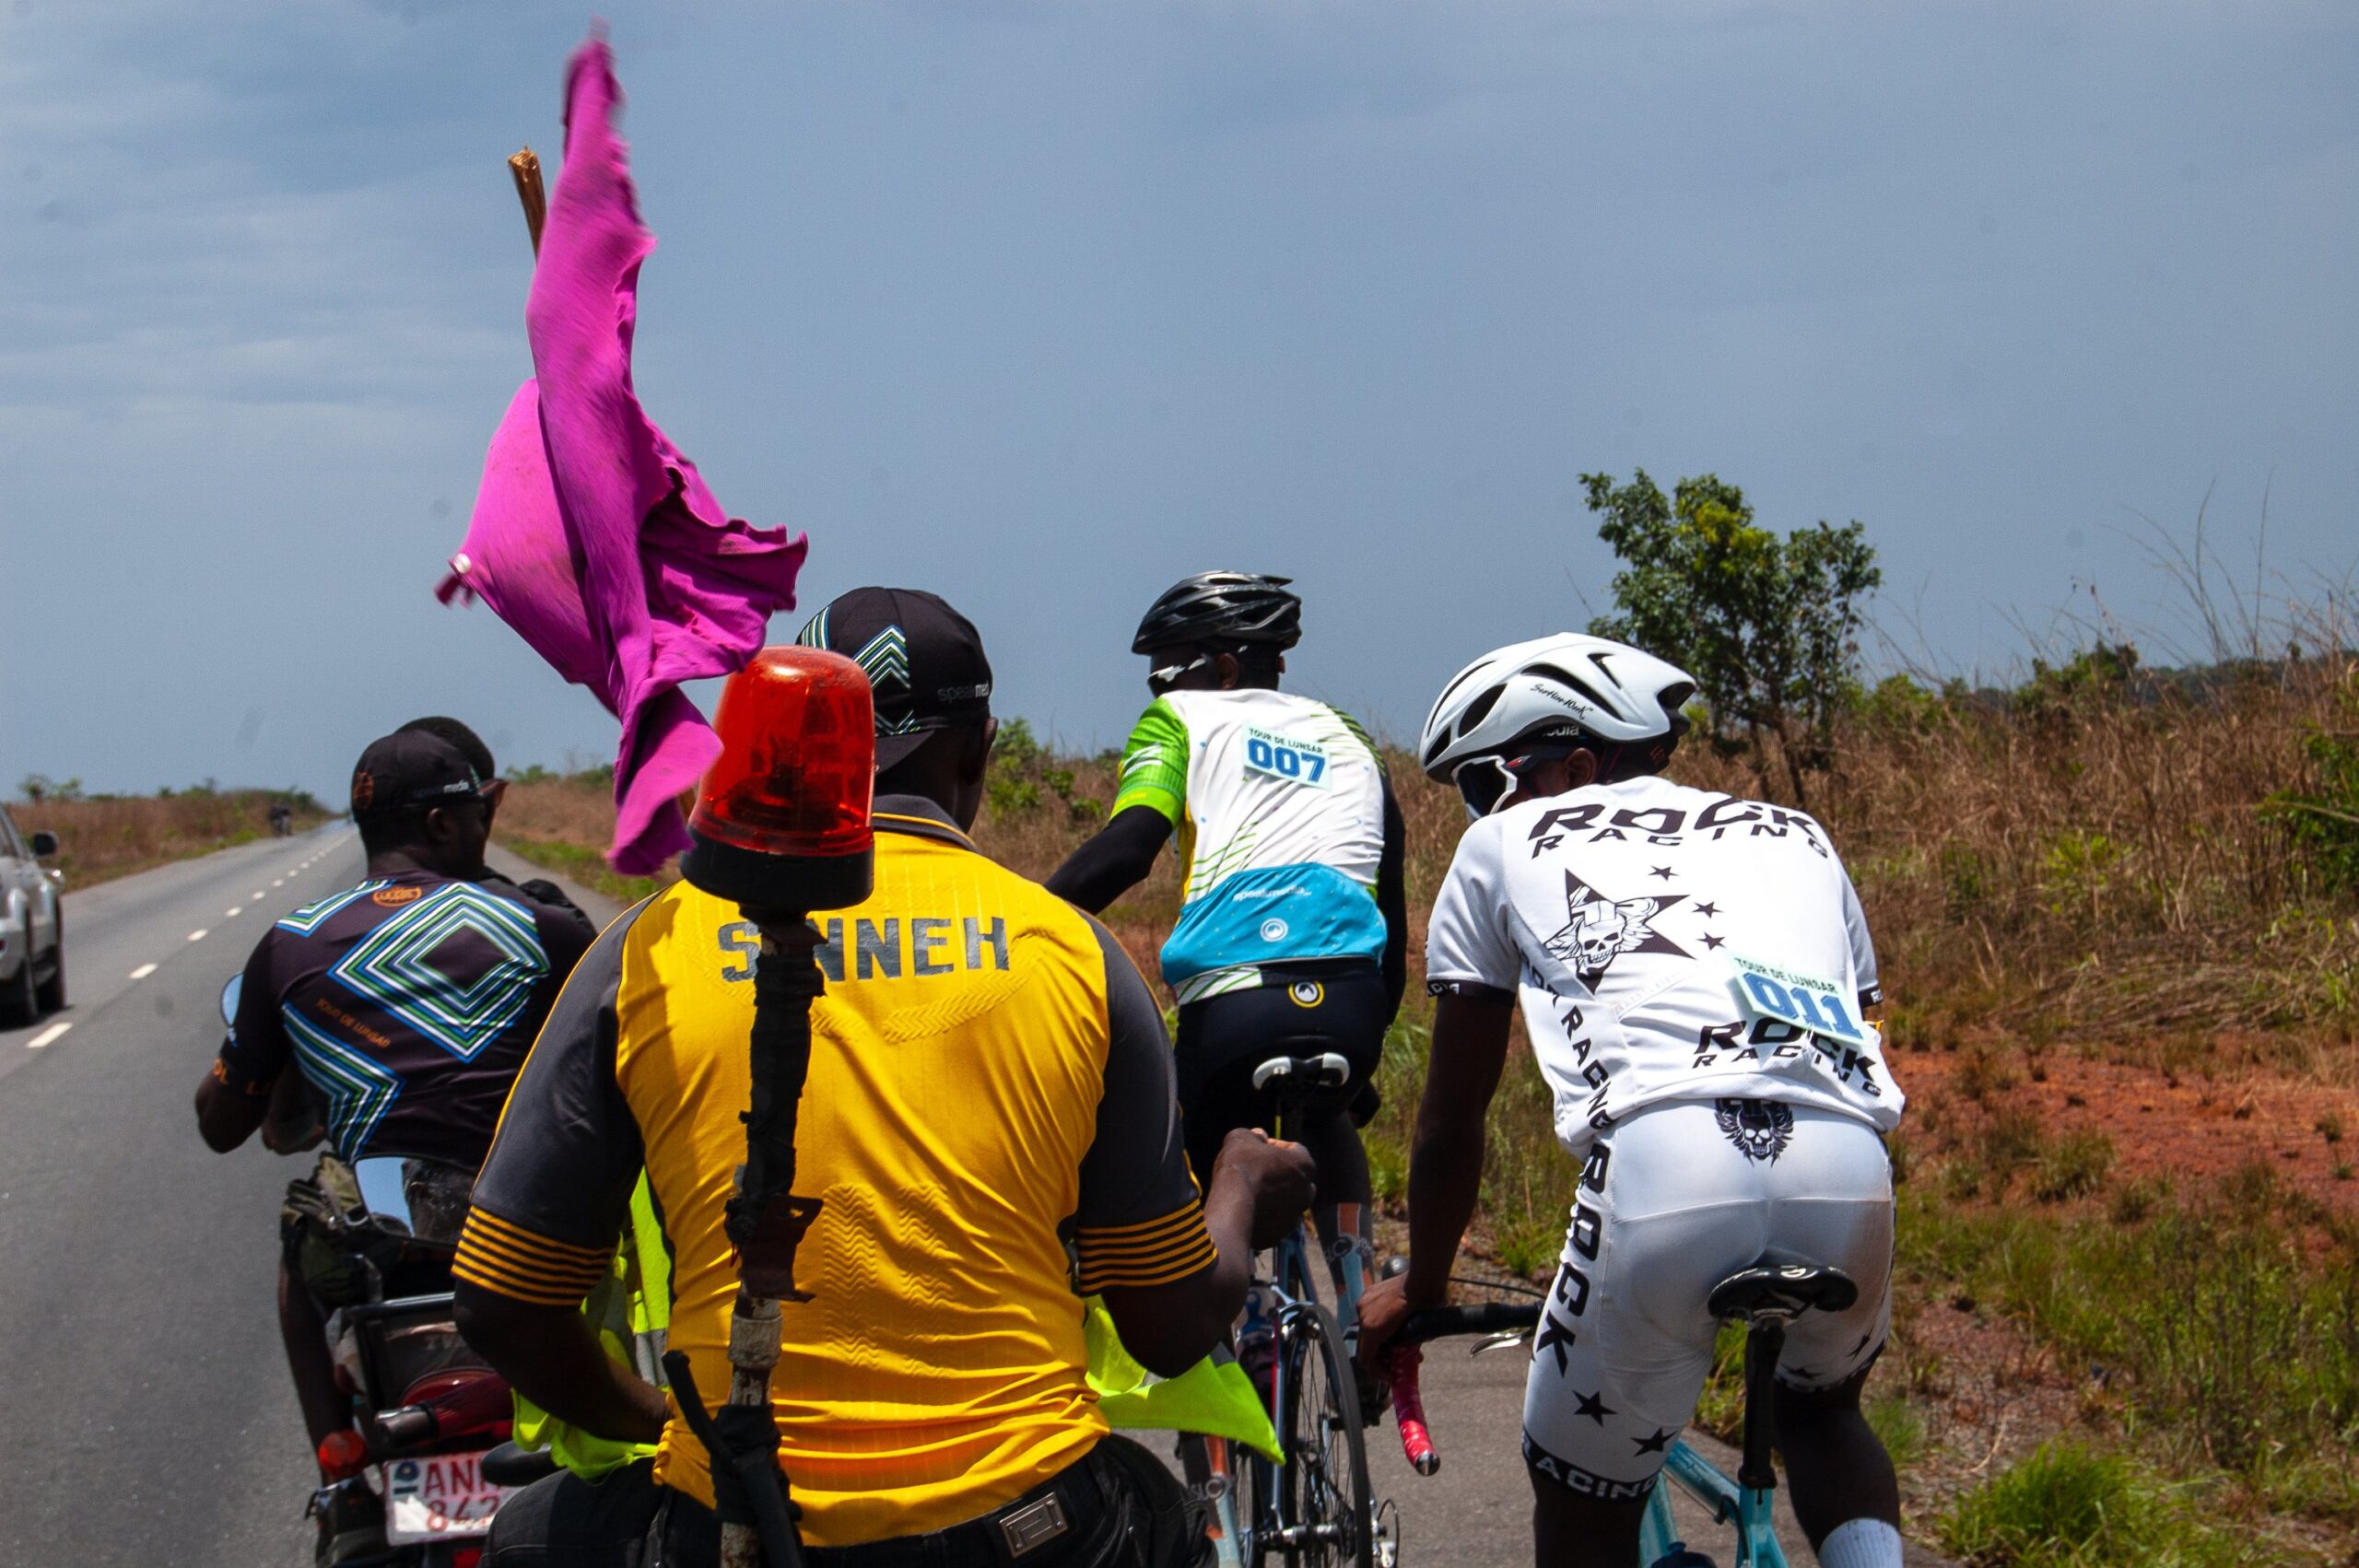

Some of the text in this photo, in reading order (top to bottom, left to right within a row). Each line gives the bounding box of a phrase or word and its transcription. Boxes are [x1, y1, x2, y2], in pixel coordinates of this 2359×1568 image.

[1248, 738, 1325, 783] 007
[1250, 728, 1323, 753] TOUR DE LUNSAR
[1528, 797, 1818, 840] ROCK
[1532, 824, 1828, 860] RACING
[719, 916, 1010, 982] SNNEH
[1734, 958, 1839, 994] TOUR DE LUNSAR
[1743, 972, 1864, 1040] 011
[1692, 1045, 1882, 1097] RACING
[1694, 1016, 1876, 1082] ROCK
[1535, 1143, 1611, 1379] ROCK
